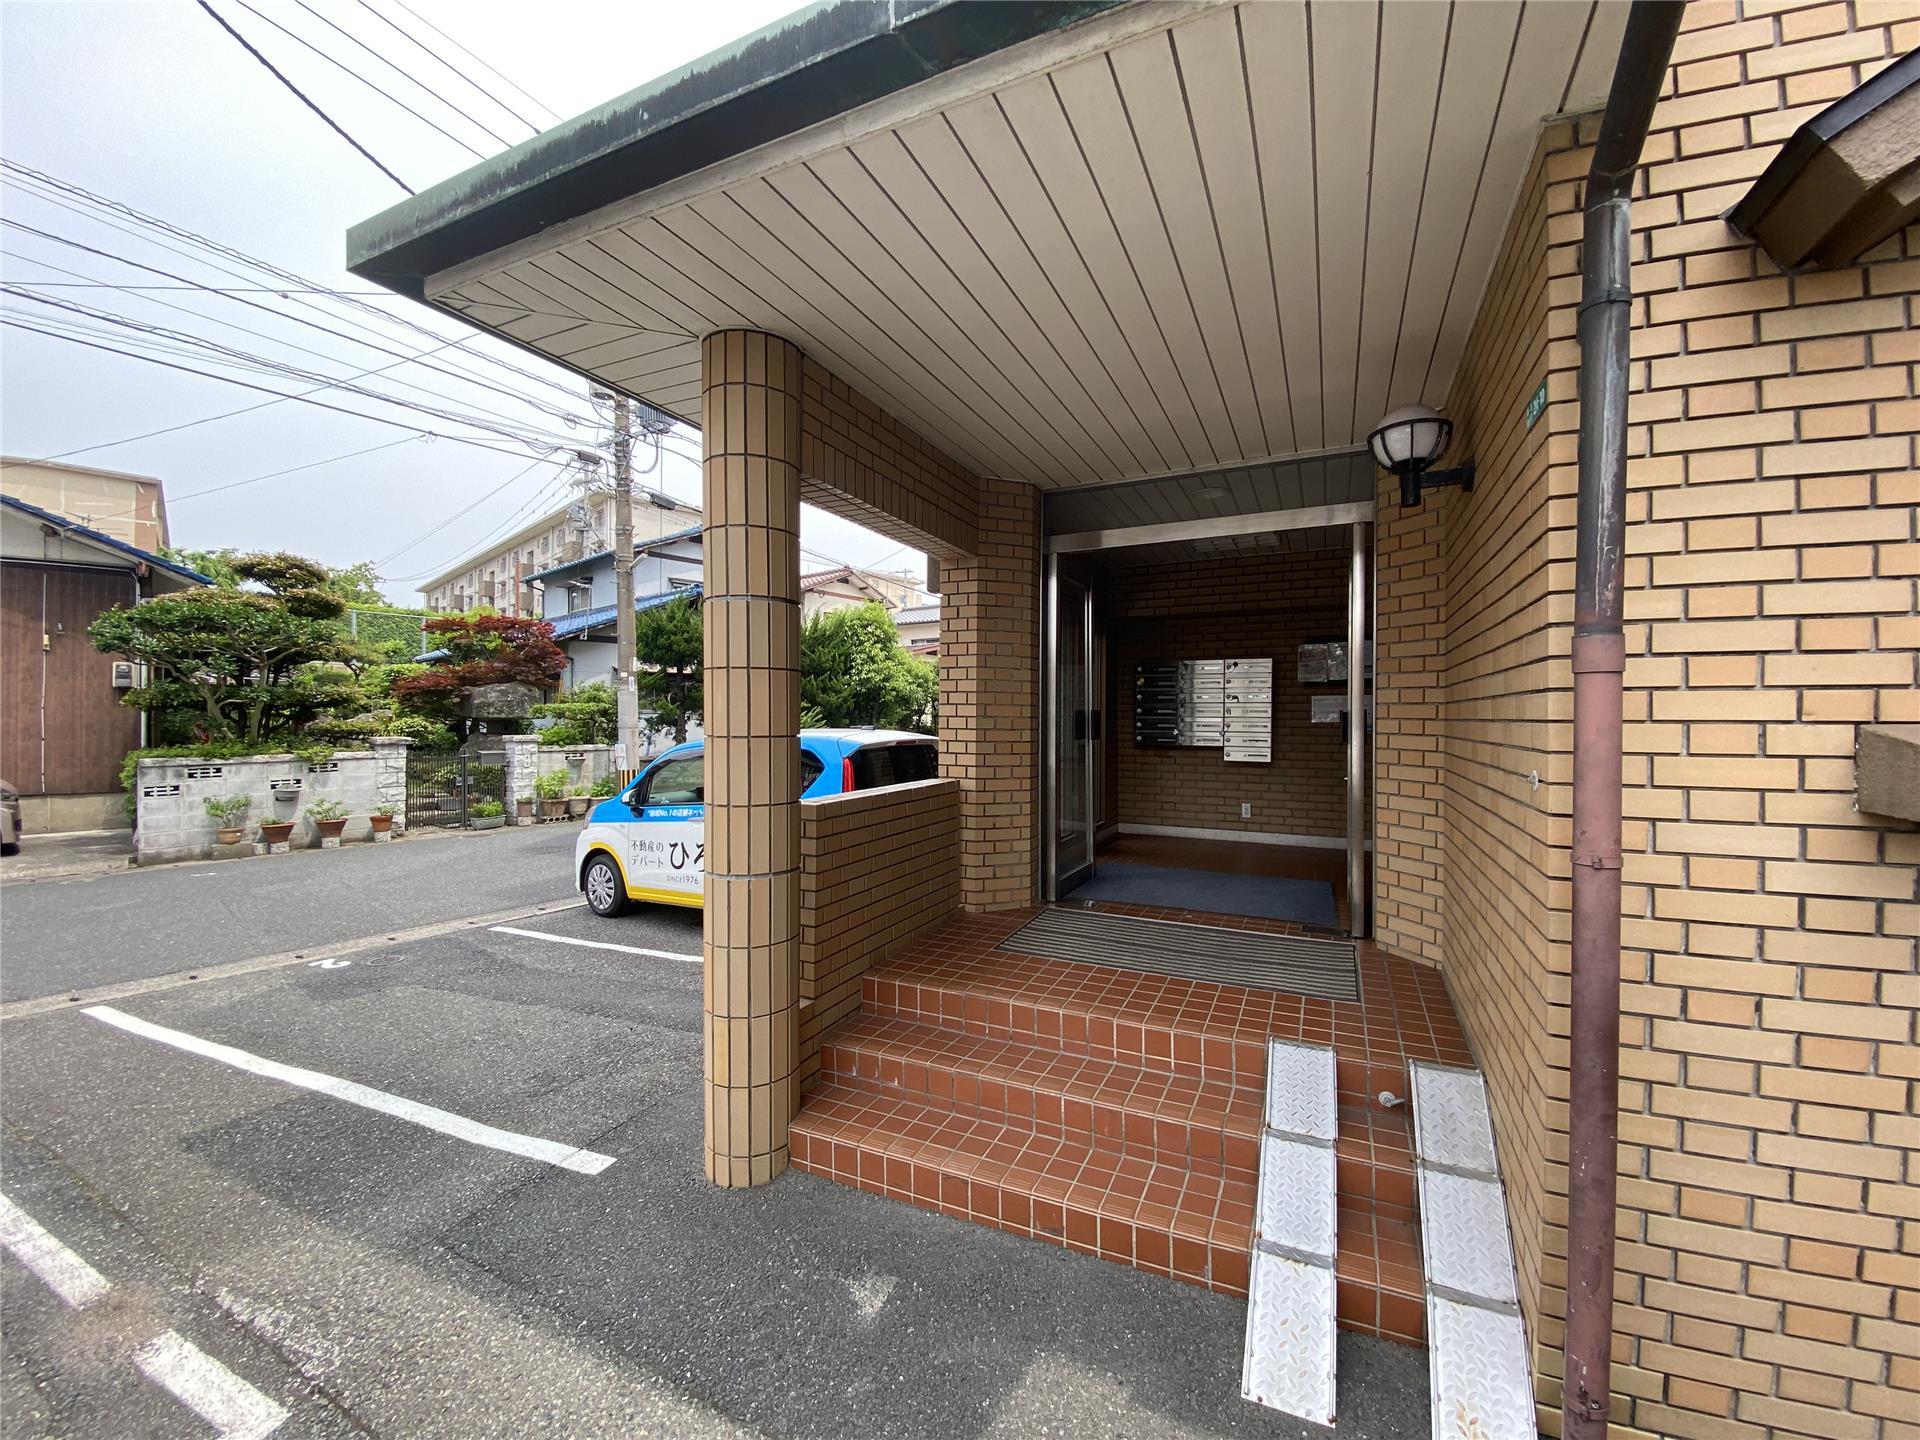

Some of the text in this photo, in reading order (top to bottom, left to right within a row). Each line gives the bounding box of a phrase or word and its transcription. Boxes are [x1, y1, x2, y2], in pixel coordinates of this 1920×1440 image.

[631, 840, 664, 852] 不動産の
[632, 855, 663, 868] デパート
